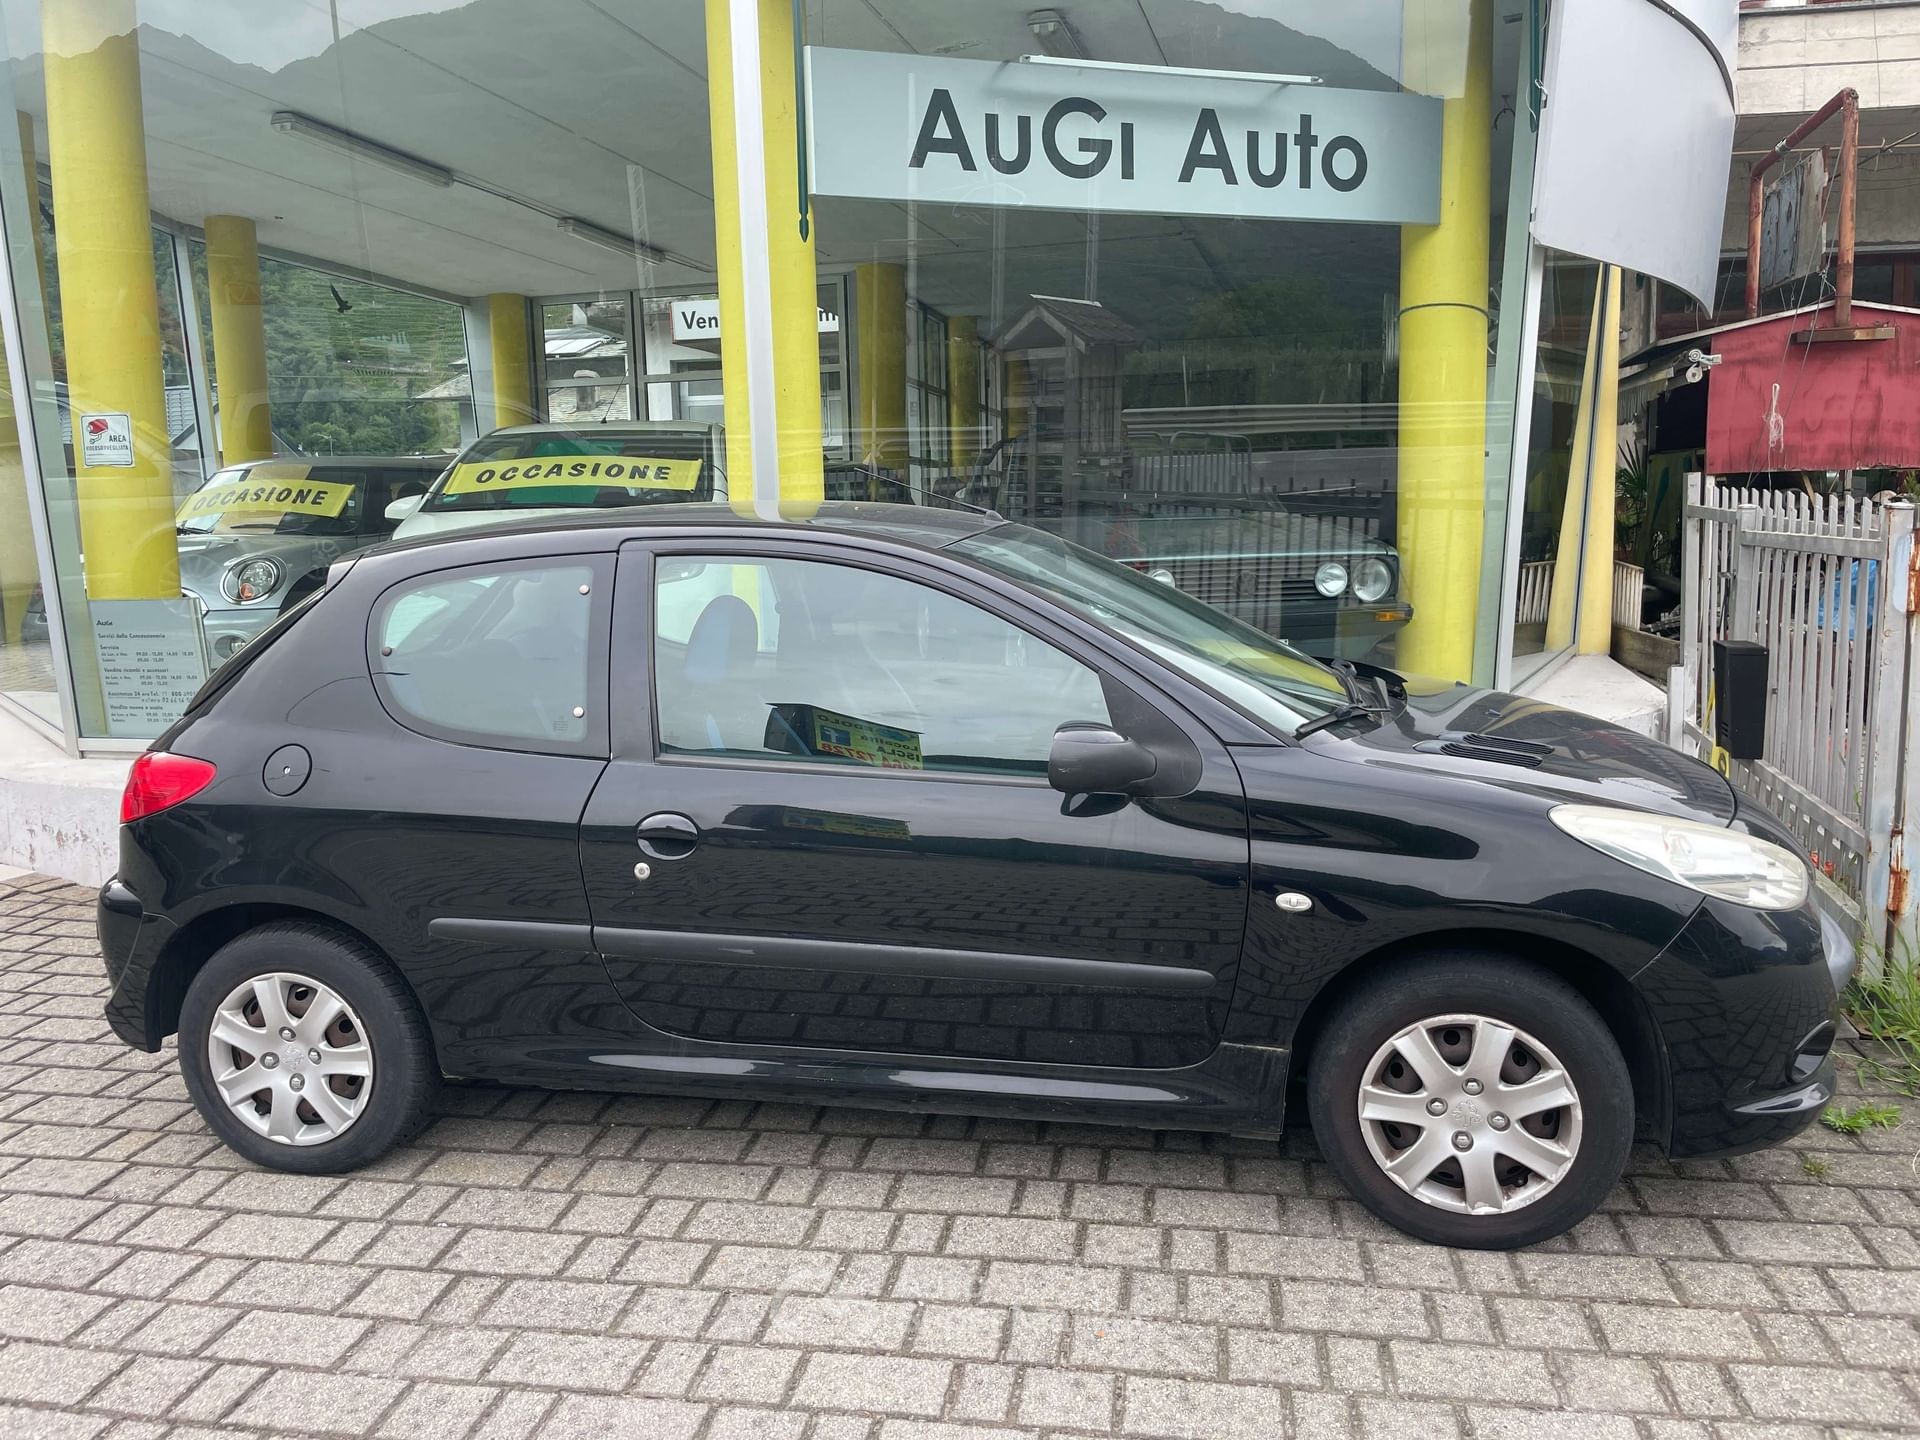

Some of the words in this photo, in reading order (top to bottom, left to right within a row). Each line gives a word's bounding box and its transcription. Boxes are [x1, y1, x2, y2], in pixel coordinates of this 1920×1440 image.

[1178, 108, 1368, 193] Auto
[109, 434, 127, 443] AREA
[475, 461, 672, 485] OCCASIONE
[193, 484, 329, 511] OCCASIONE
